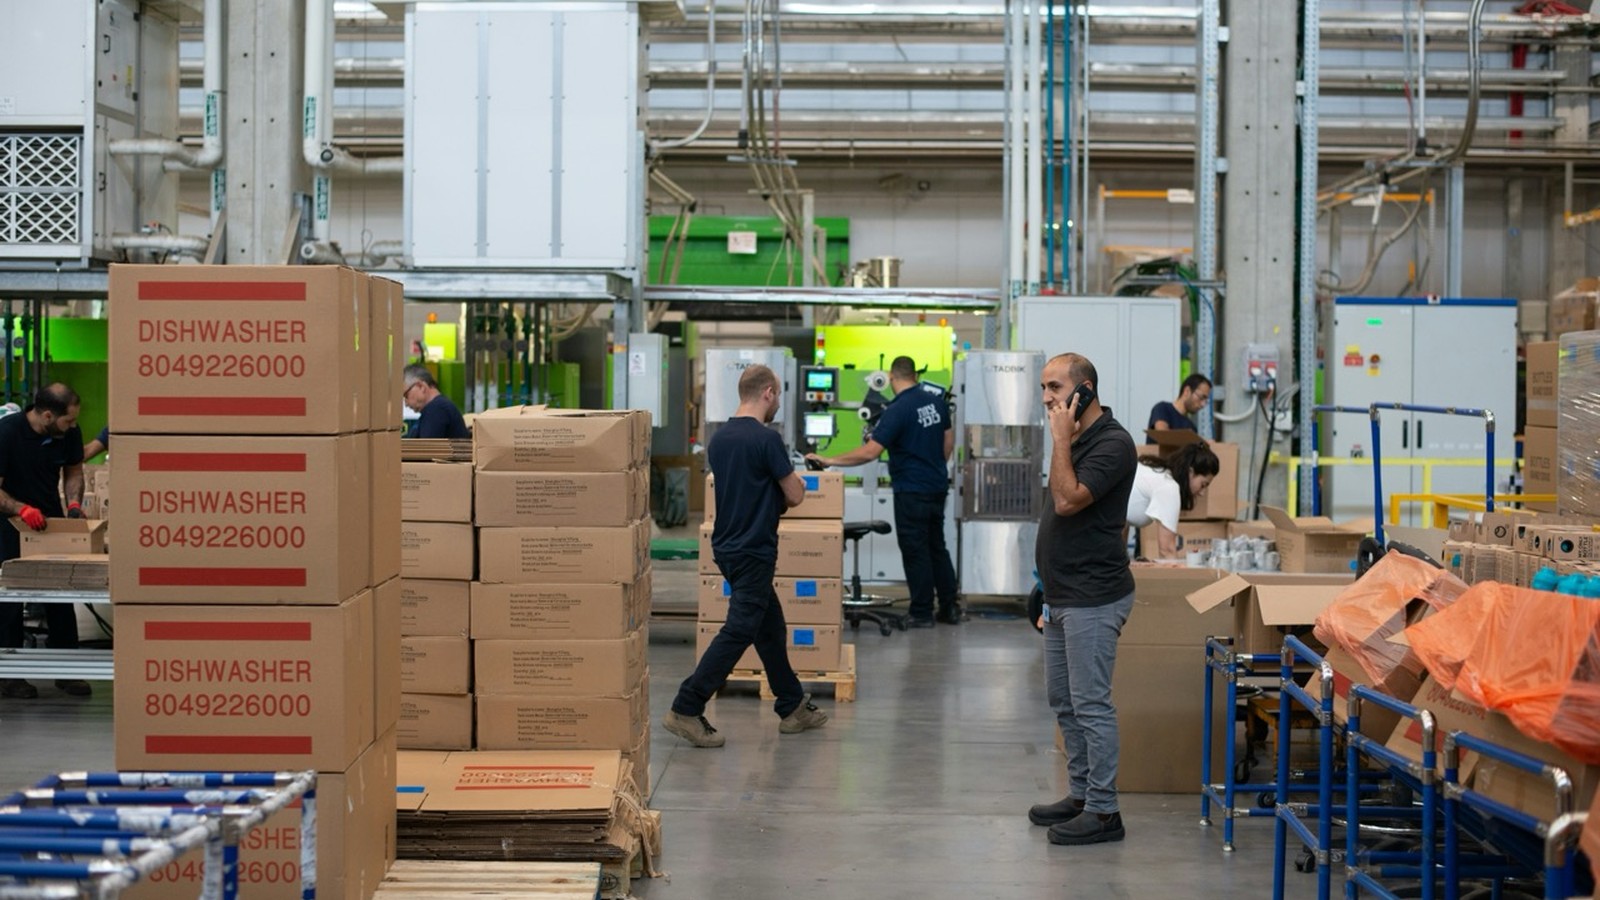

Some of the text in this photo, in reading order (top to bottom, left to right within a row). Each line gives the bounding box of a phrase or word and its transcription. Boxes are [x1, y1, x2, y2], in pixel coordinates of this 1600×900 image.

[139, 320, 306, 343] DISHWASHER
[139, 354, 305, 377] 8049226000
[139, 491, 306, 513] DISHWASHER
[139, 525, 305, 548] 8049226000
[145, 660, 311, 683] DISHWASHER
[145, 693, 311, 716] 8049226000
[149, 860, 303, 883] 8042600
